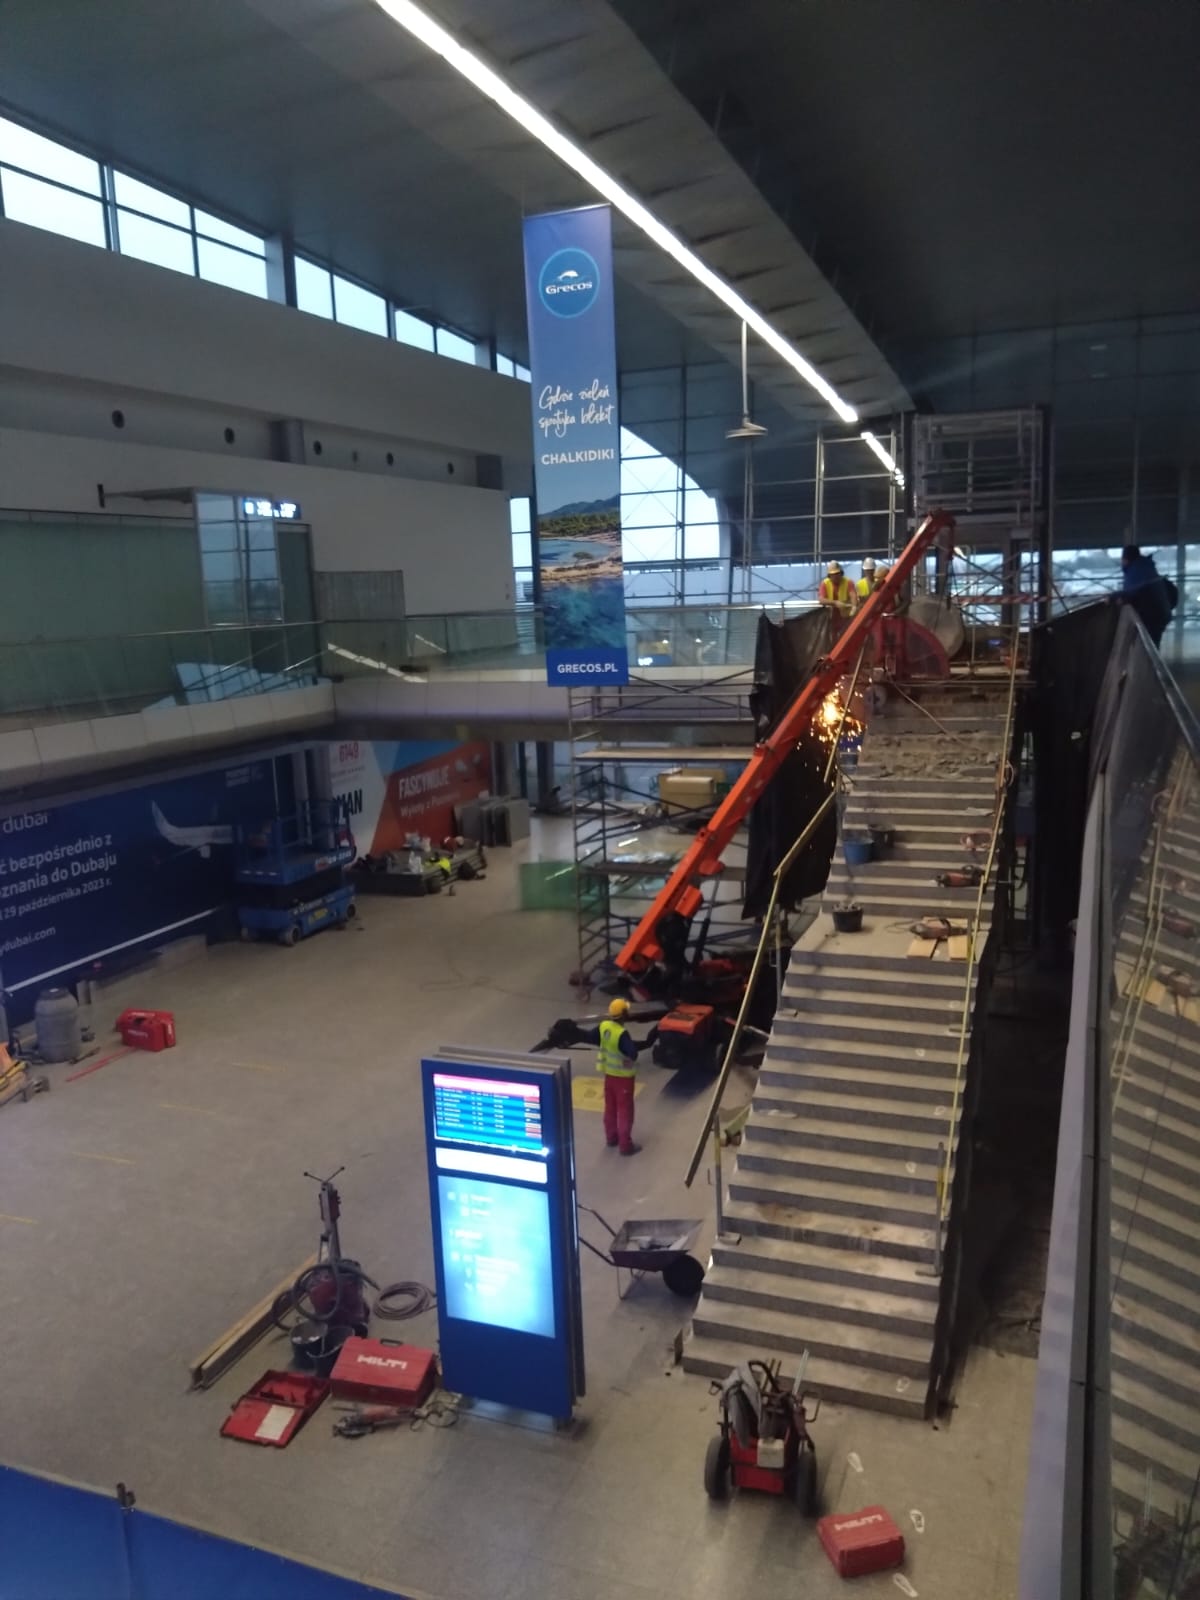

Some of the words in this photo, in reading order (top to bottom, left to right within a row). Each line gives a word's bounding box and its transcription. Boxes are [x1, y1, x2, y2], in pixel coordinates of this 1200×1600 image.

[545, 281, 593, 295] Grecos
[539, 385, 574, 411] Gdzie
[541, 448, 615, 465] CHALKIDIKI
[557, 663, 619, 674] GRECOS.PL
[2, 812, 49, 834] dubai
[9, 835, 103, 873] bezpośrednio
[104, 834, 112, 846] z
[0, 872, 49, 899] znania
[51, 867, 69, 883] do
[71, 851, 117, 877] Dubaju
[4, 905, 16, 920] 29
[82, 877, 104, 894] 2023
